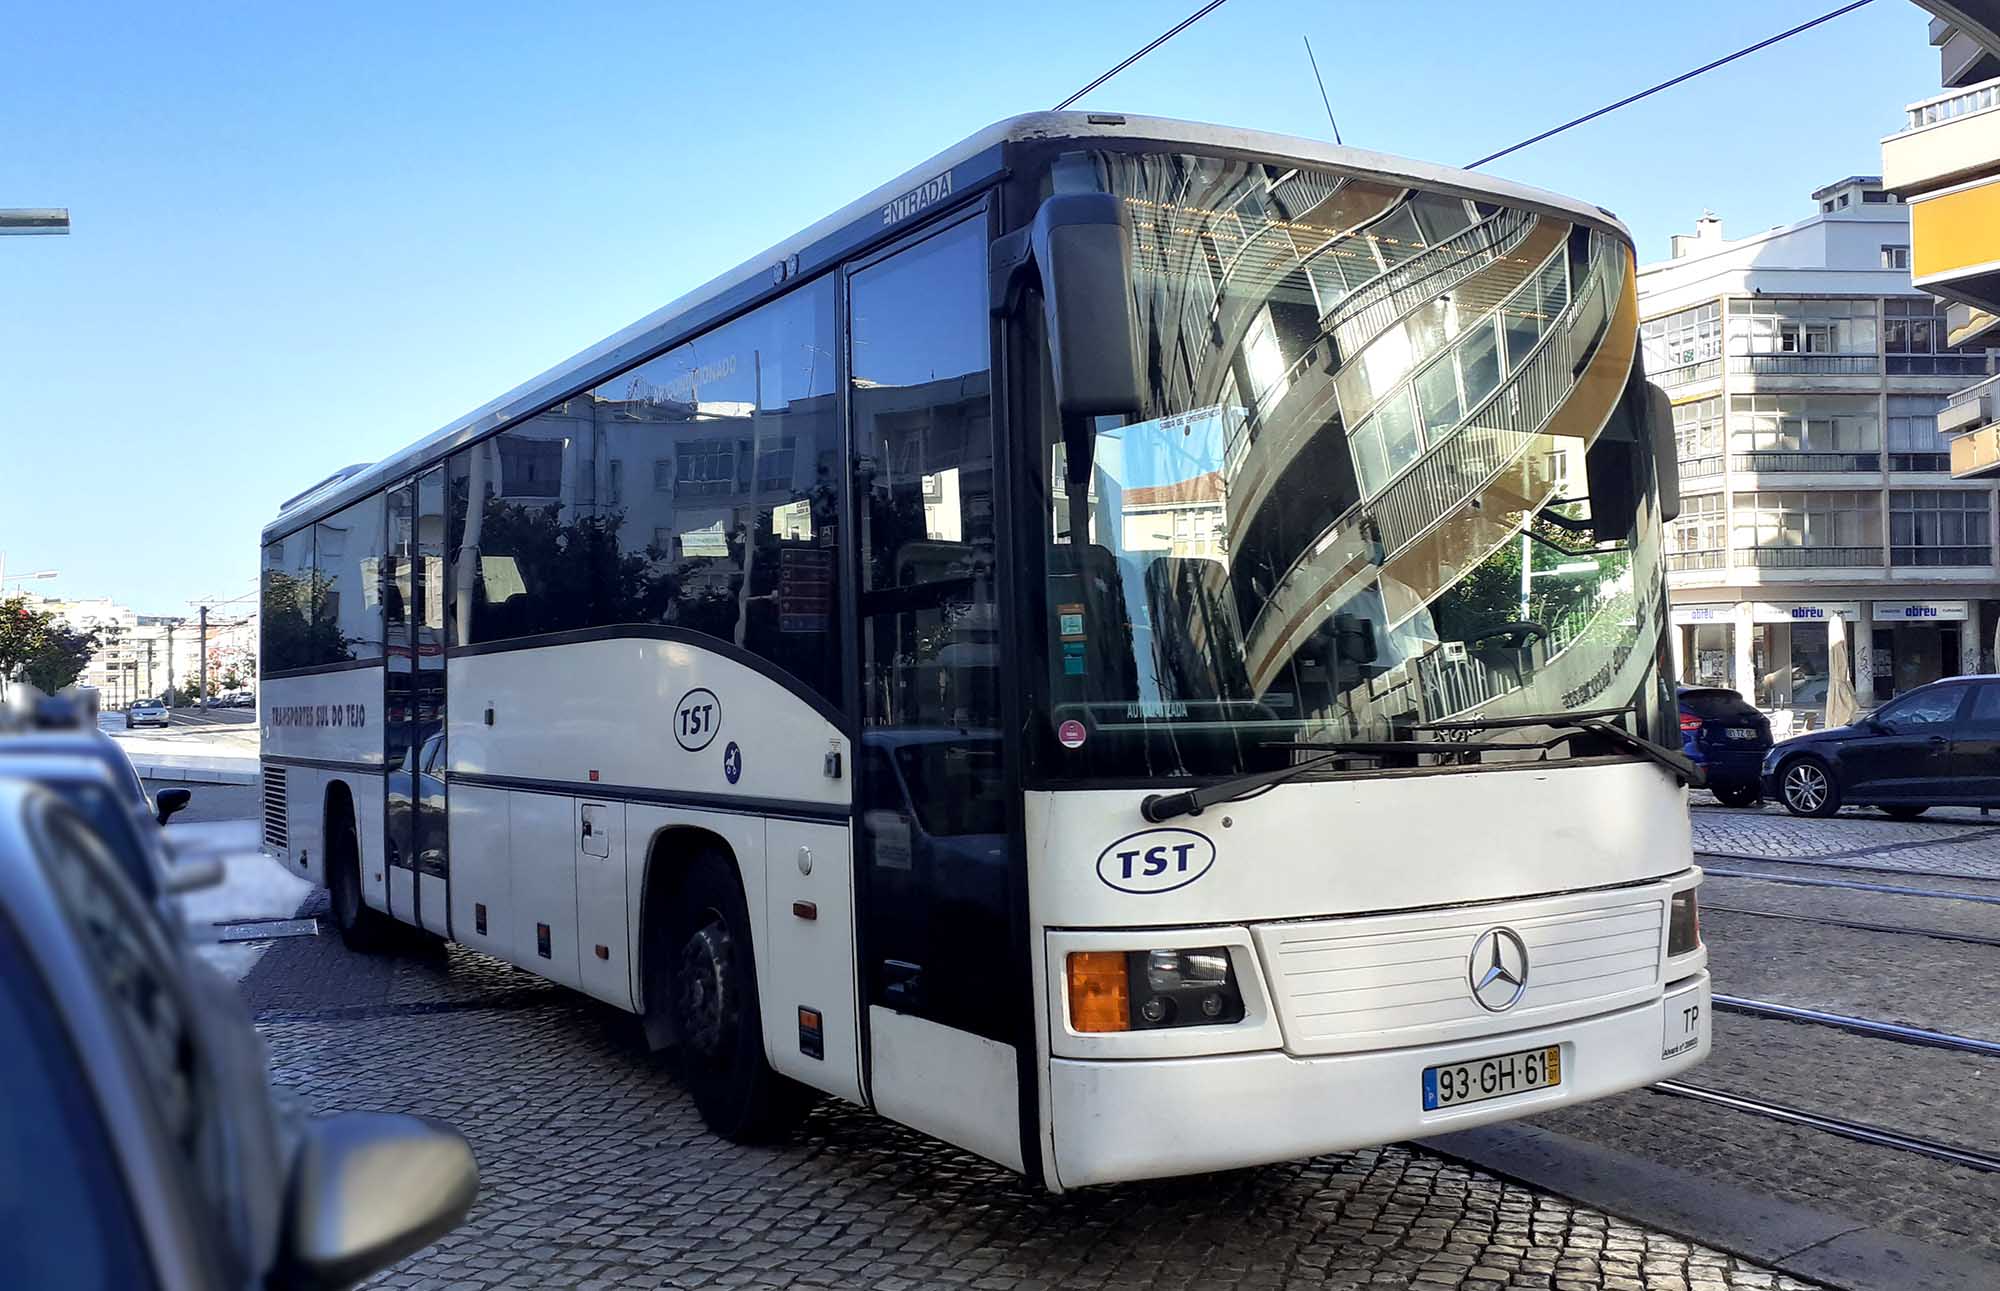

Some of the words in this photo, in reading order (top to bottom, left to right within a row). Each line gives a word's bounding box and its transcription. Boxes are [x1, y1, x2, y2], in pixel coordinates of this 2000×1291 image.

[881, 174, 951, 225] ENTRADA
[1792, 606, 1823, 618] abreu
[1905, 606, 1937, 617] abreu
[332, 704, 343, 727] DO
[346, 704, 365, 728] TEJO
[681, 704, 712, 736] TST
[1116, 843, 1195, 879] TST
[1683, 1005, 1699, 1033] TP
